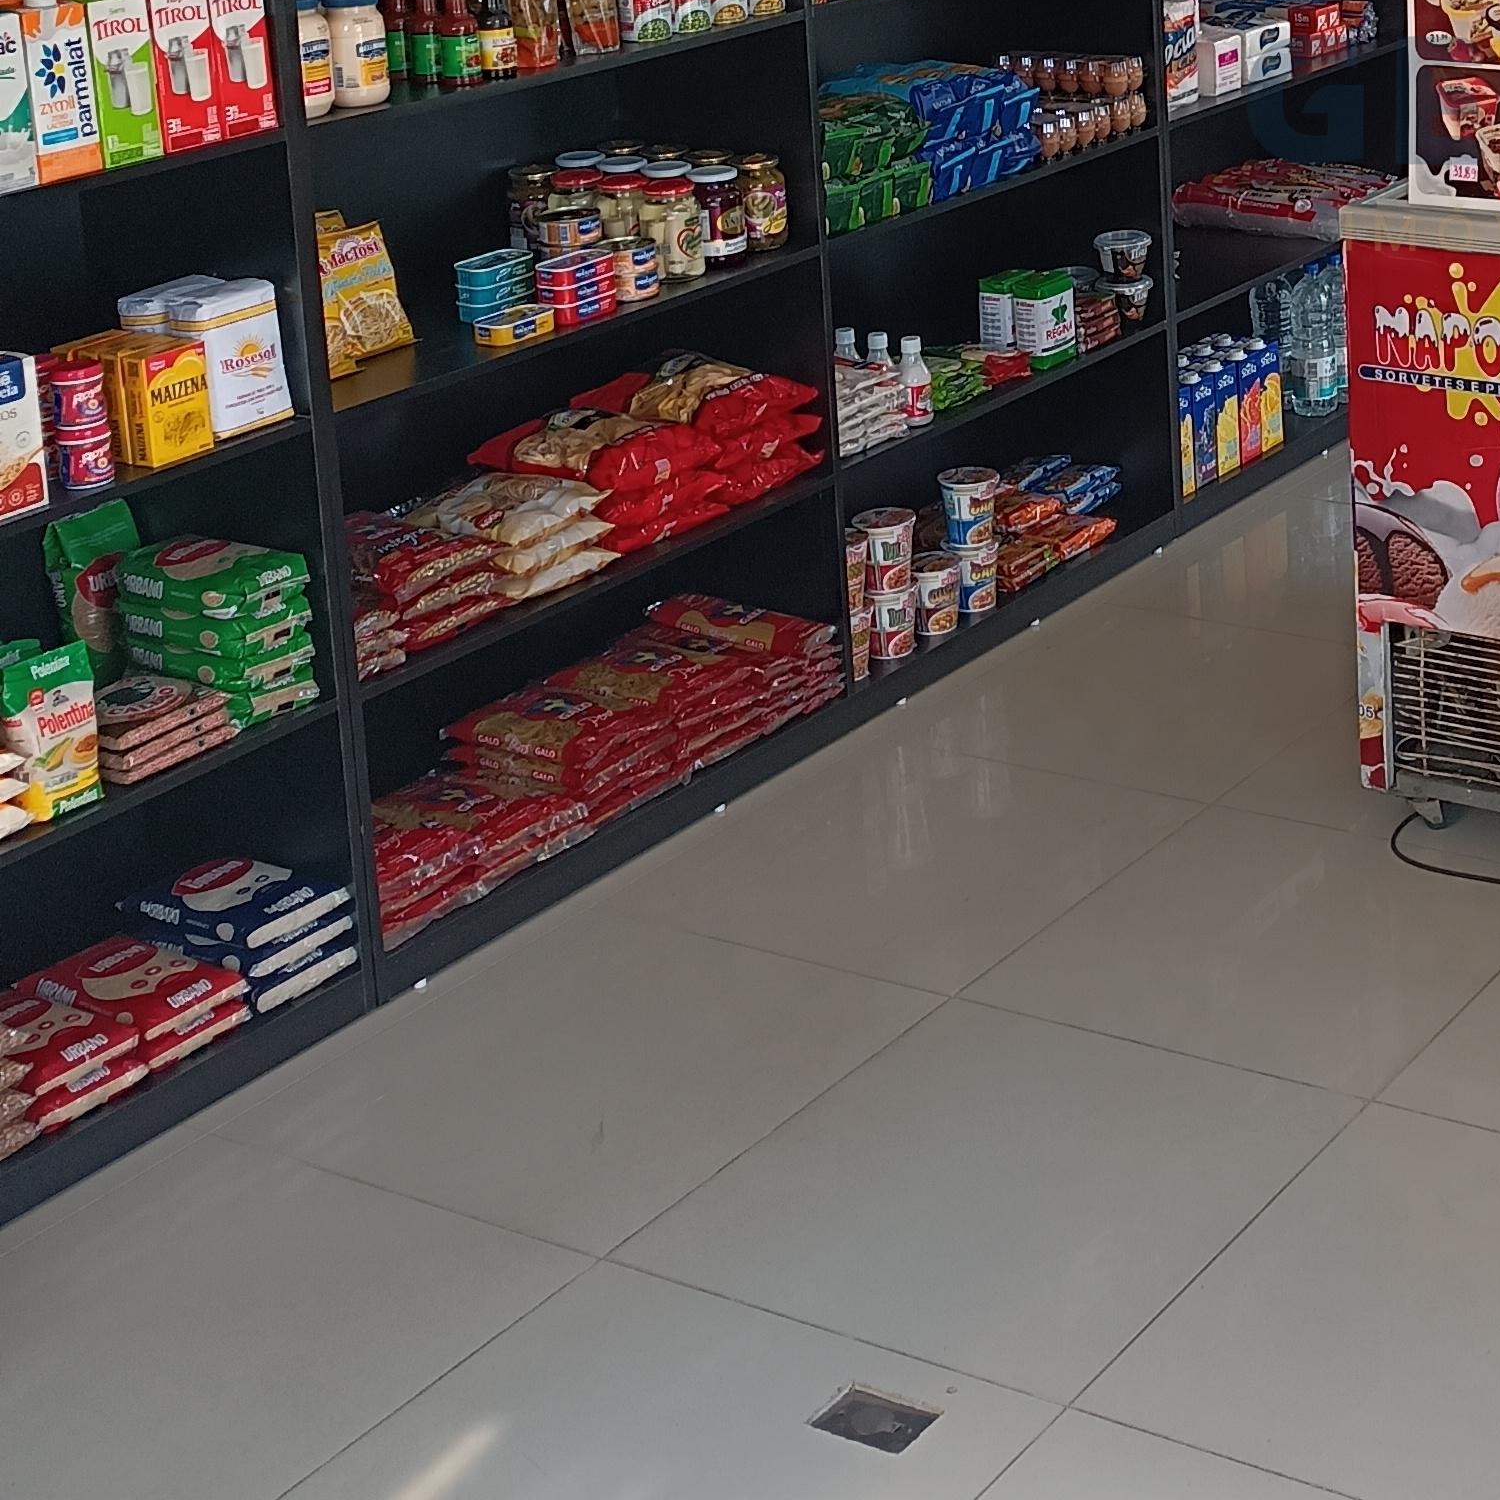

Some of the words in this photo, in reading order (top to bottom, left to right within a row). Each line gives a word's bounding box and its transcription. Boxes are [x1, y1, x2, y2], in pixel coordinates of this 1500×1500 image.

[93, 17, 147, 41] TIROL
[154, 5, 207, 29] TIROL
[64, 37, 97, 137] parmalat
[150, 373, 209, 407] MAIZENA
[1375, 368, 1464, 391] SORVETES
[37, 701, 95, 737] Polentina
